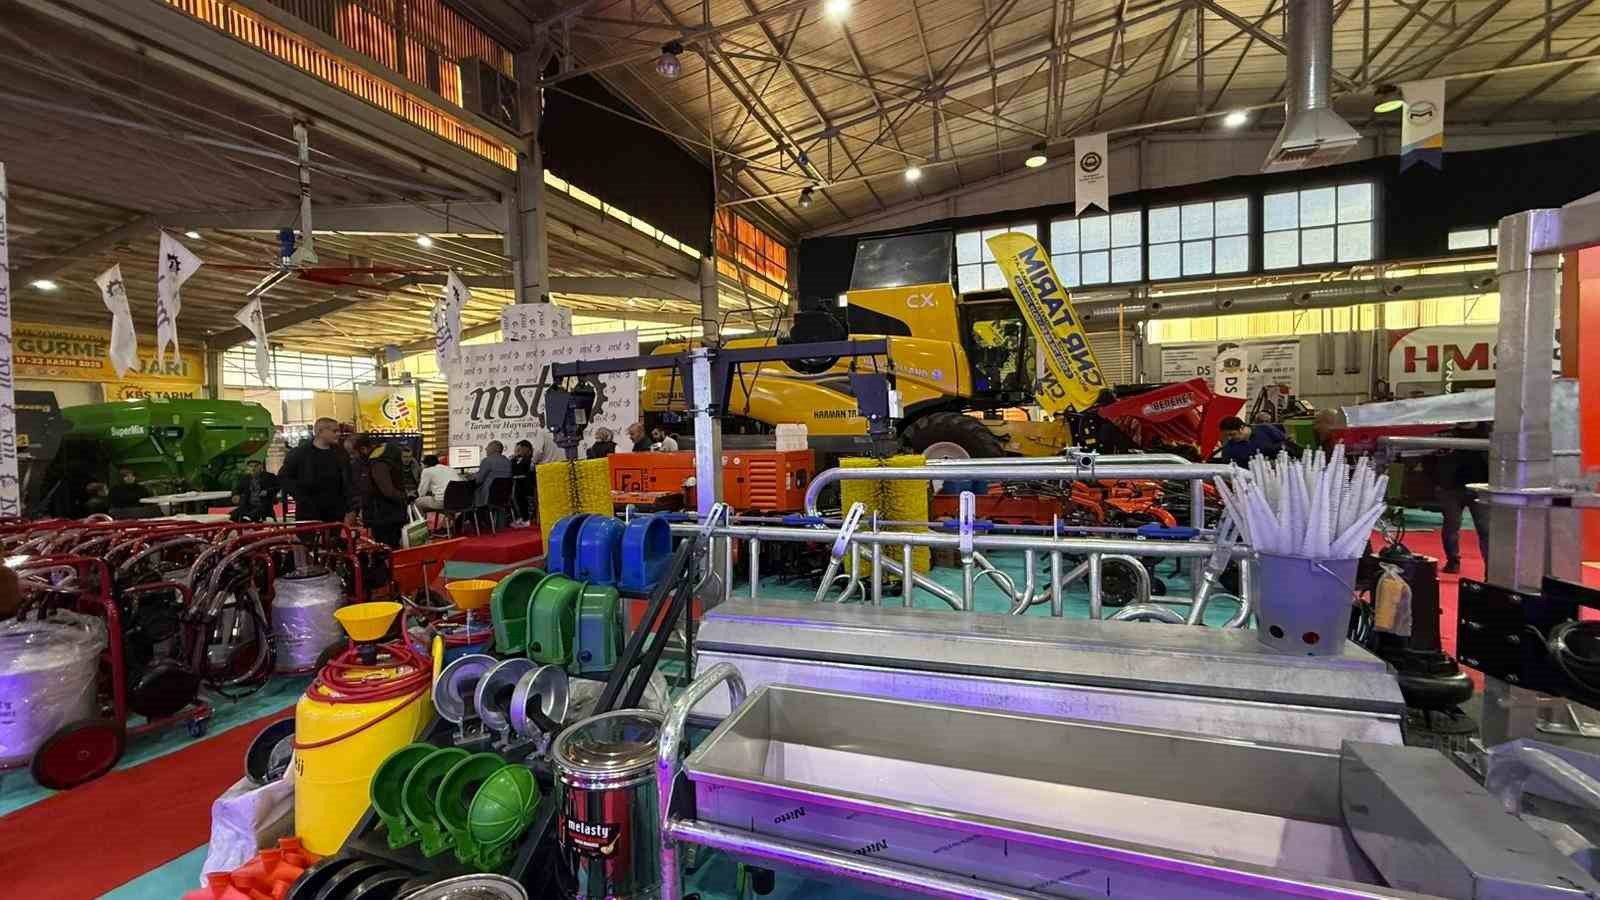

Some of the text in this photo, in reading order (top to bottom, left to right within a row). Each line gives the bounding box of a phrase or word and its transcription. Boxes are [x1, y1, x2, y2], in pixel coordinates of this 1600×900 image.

[1404, 342, 1497, 373] HM
[125, 391, 193, 400] KBS TARIM
[814, 409, 847, 419] HARMAN
[774, 806, 808, 825] Nitto
[568, 819, 609, 839] melasty
